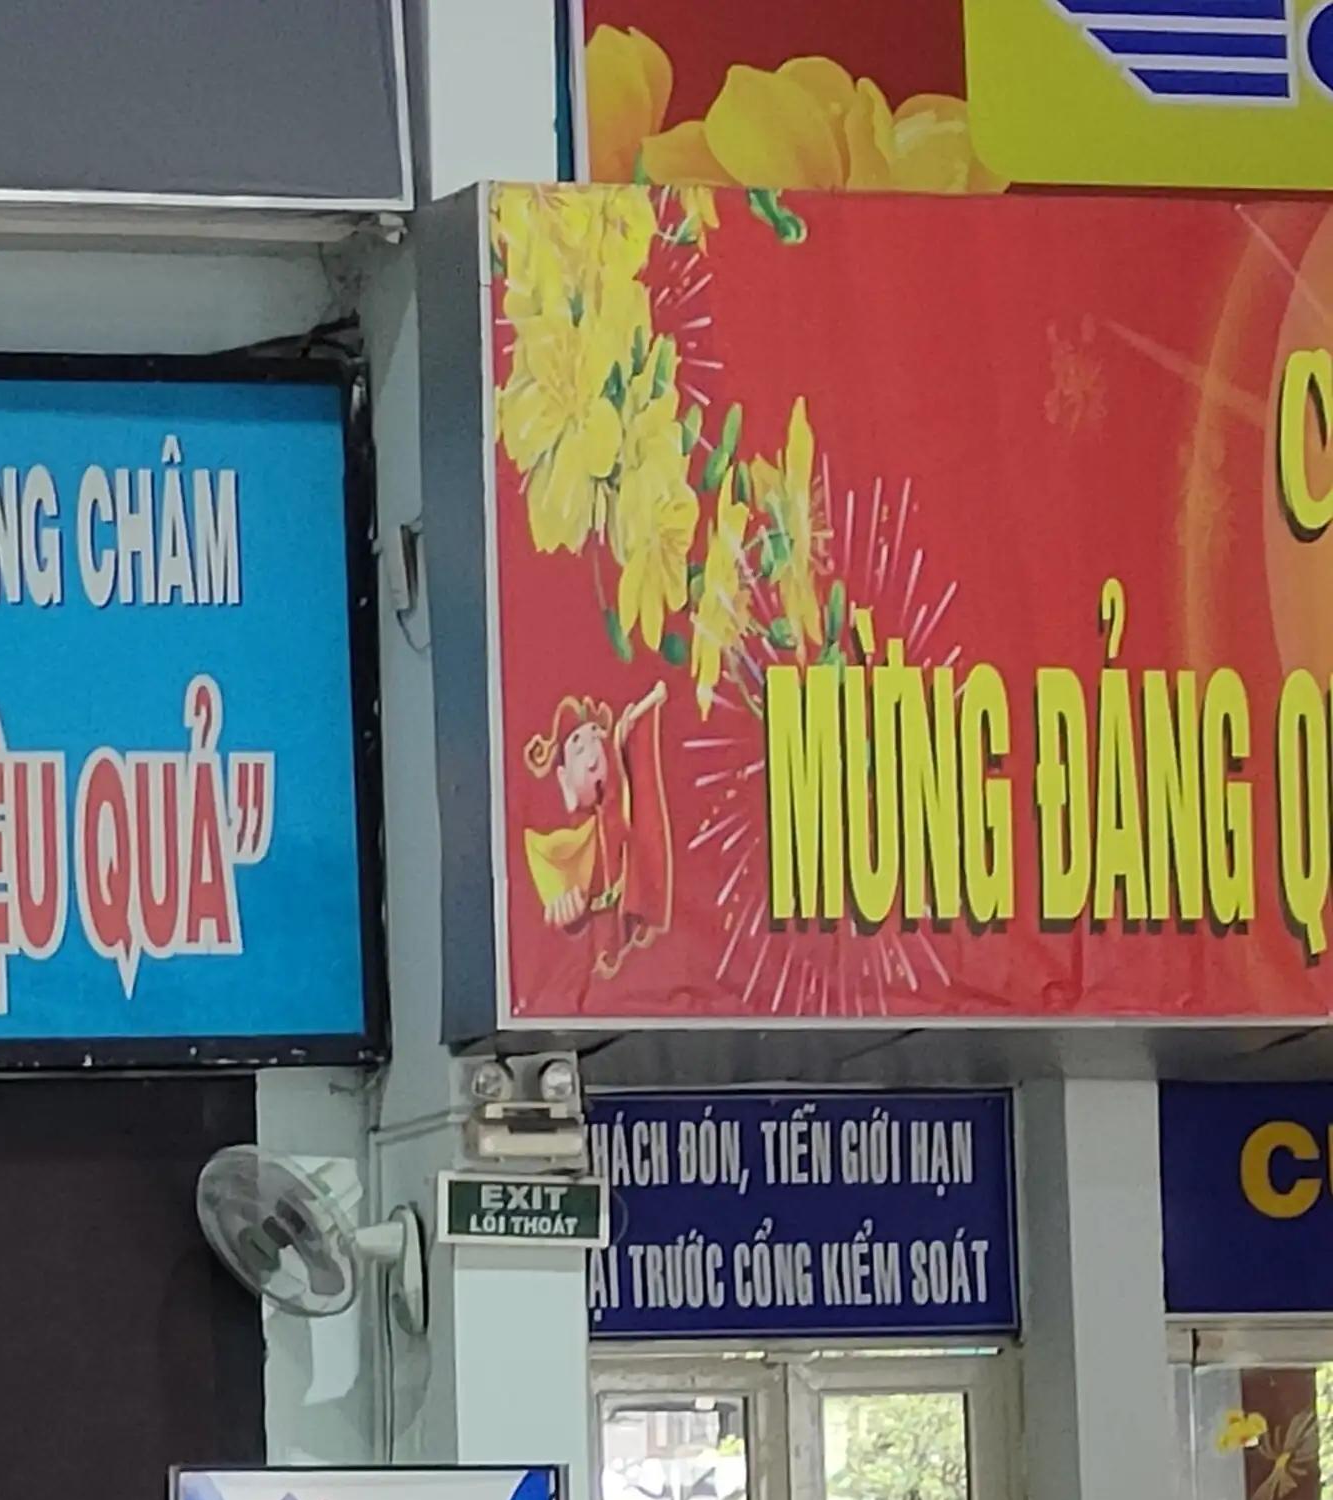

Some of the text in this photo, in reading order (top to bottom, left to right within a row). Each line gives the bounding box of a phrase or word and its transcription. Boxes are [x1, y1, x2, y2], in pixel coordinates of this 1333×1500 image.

[77, 434, 242, 606] CHÂM
[765, 578, 1333, 955] MỪNG ĐẢNG Q
[586, 1110, 669, 1187] HÁCH
[760, 1103, 831, 1185] TIỄN
[841, 1106, 901, 1184] GIỚI
[910, 1120, 973, 1196] HẠN
[481, 1184, 567, 1212] EXIT
[511, 1213, 578, 1236] THOÁT
[628, 1228, 725, 1309] TRƯỚC
[733, 1217, 813, 1308] CỔNG
[822, 1219, 902, 1306] KIỂM
[910, 1227, 988, 1305] SOÁT
